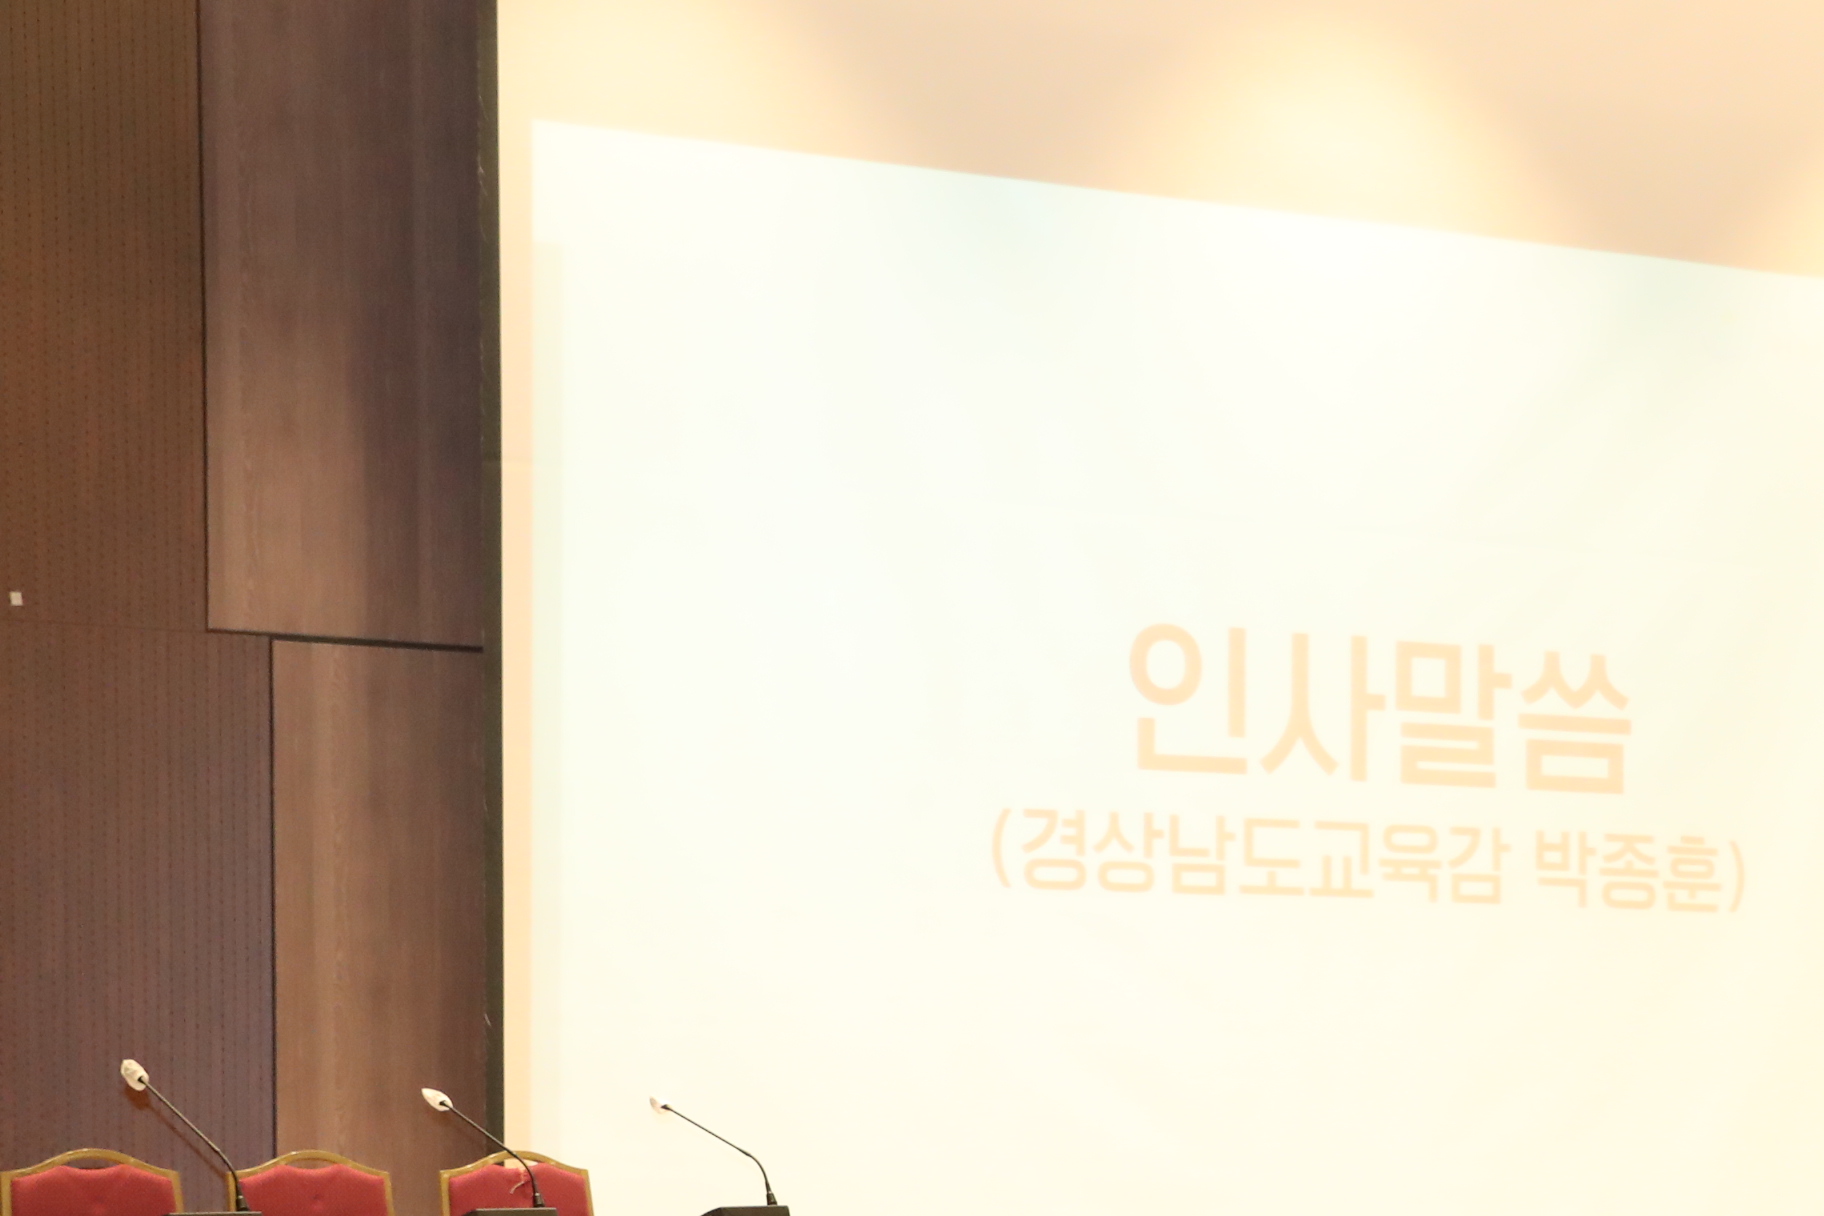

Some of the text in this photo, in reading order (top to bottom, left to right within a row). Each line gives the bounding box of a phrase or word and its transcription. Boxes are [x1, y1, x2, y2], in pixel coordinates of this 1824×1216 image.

[1129, 623, 1632, 795] 인사말씀
[992, 807, 1746, 913] (경상남도교육감 박종훈)
